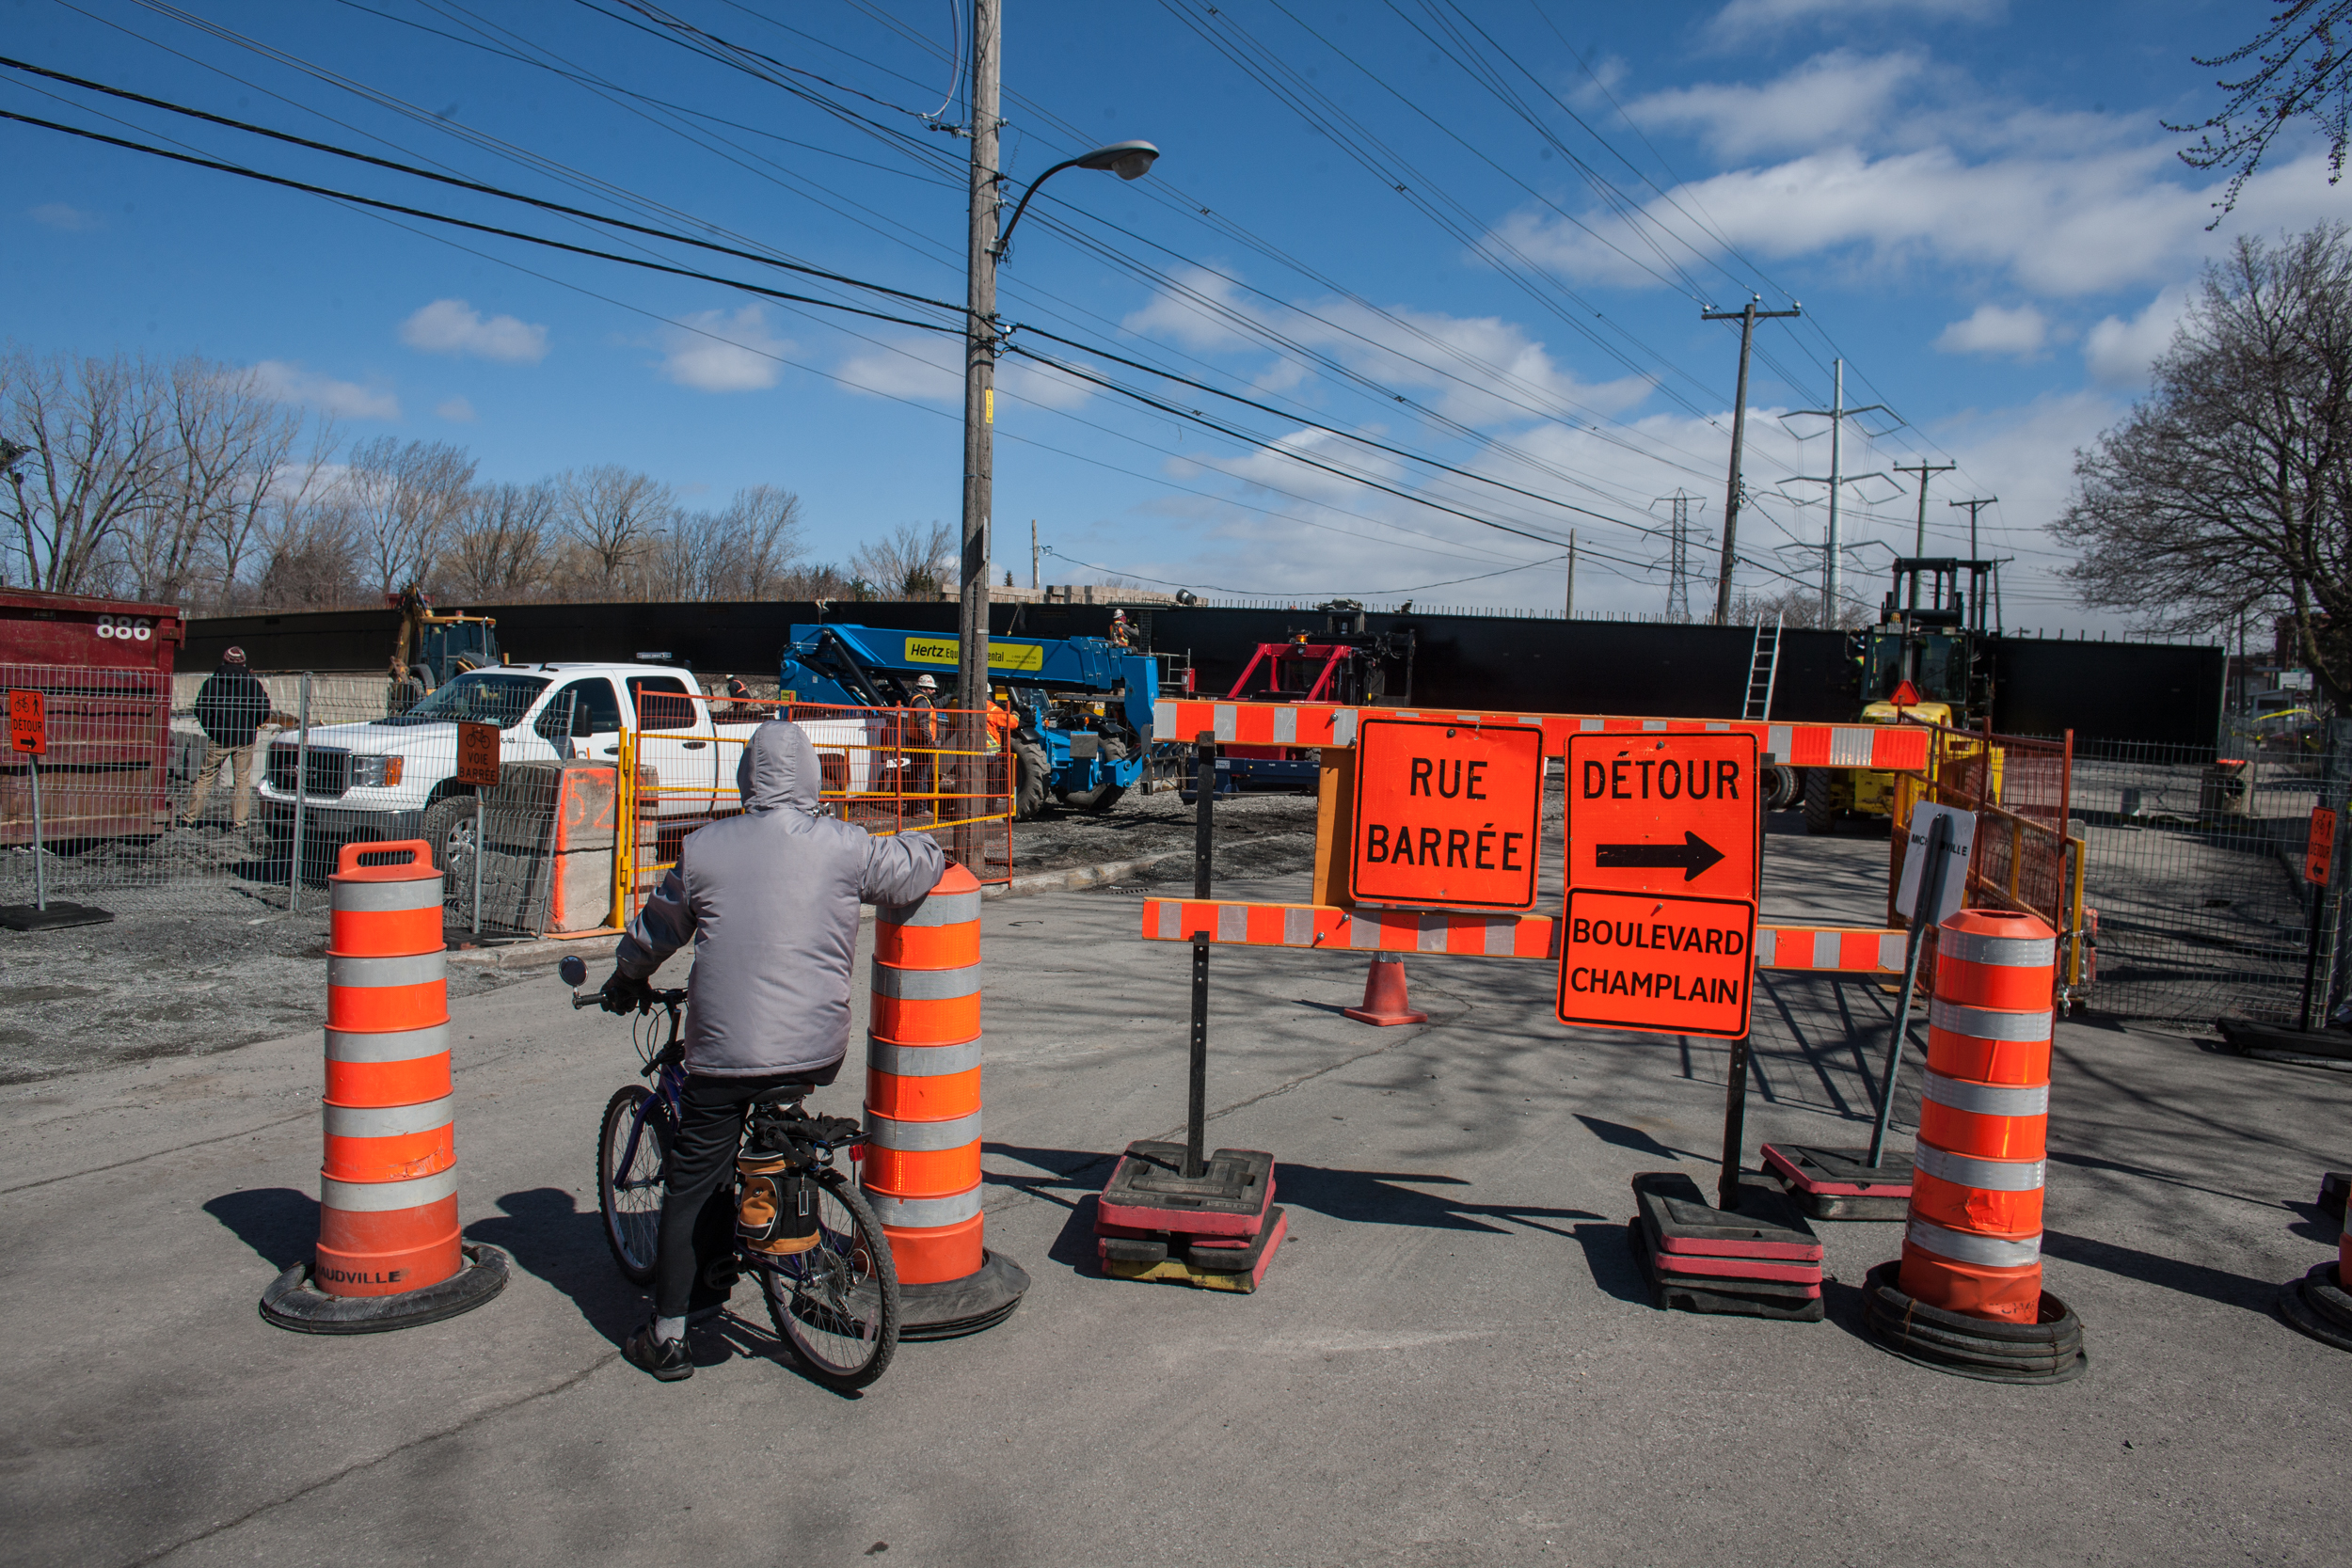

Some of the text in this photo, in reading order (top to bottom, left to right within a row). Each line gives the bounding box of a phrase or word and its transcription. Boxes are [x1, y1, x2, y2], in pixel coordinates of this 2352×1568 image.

[97, 614, 151, 641] 886
[911, 643, 945, 657] Hertz
[988, 651, 1004, 662] ental
[13, 717, 42, 733] DÉTOUR
[459, 766, 496, 782] BARRÉE
[468, 752, 488, 765] VOIE
[1410, 756, 1488, 800] RUE
[1583, 751, 1740, 800] DÉTOUR
[1366, 823, 1523, 871] BARRÉE
[1572, 917, 1744, 956] BOULEVARD
[1571, 967, 1739, 1006] CHAMPLAIN
